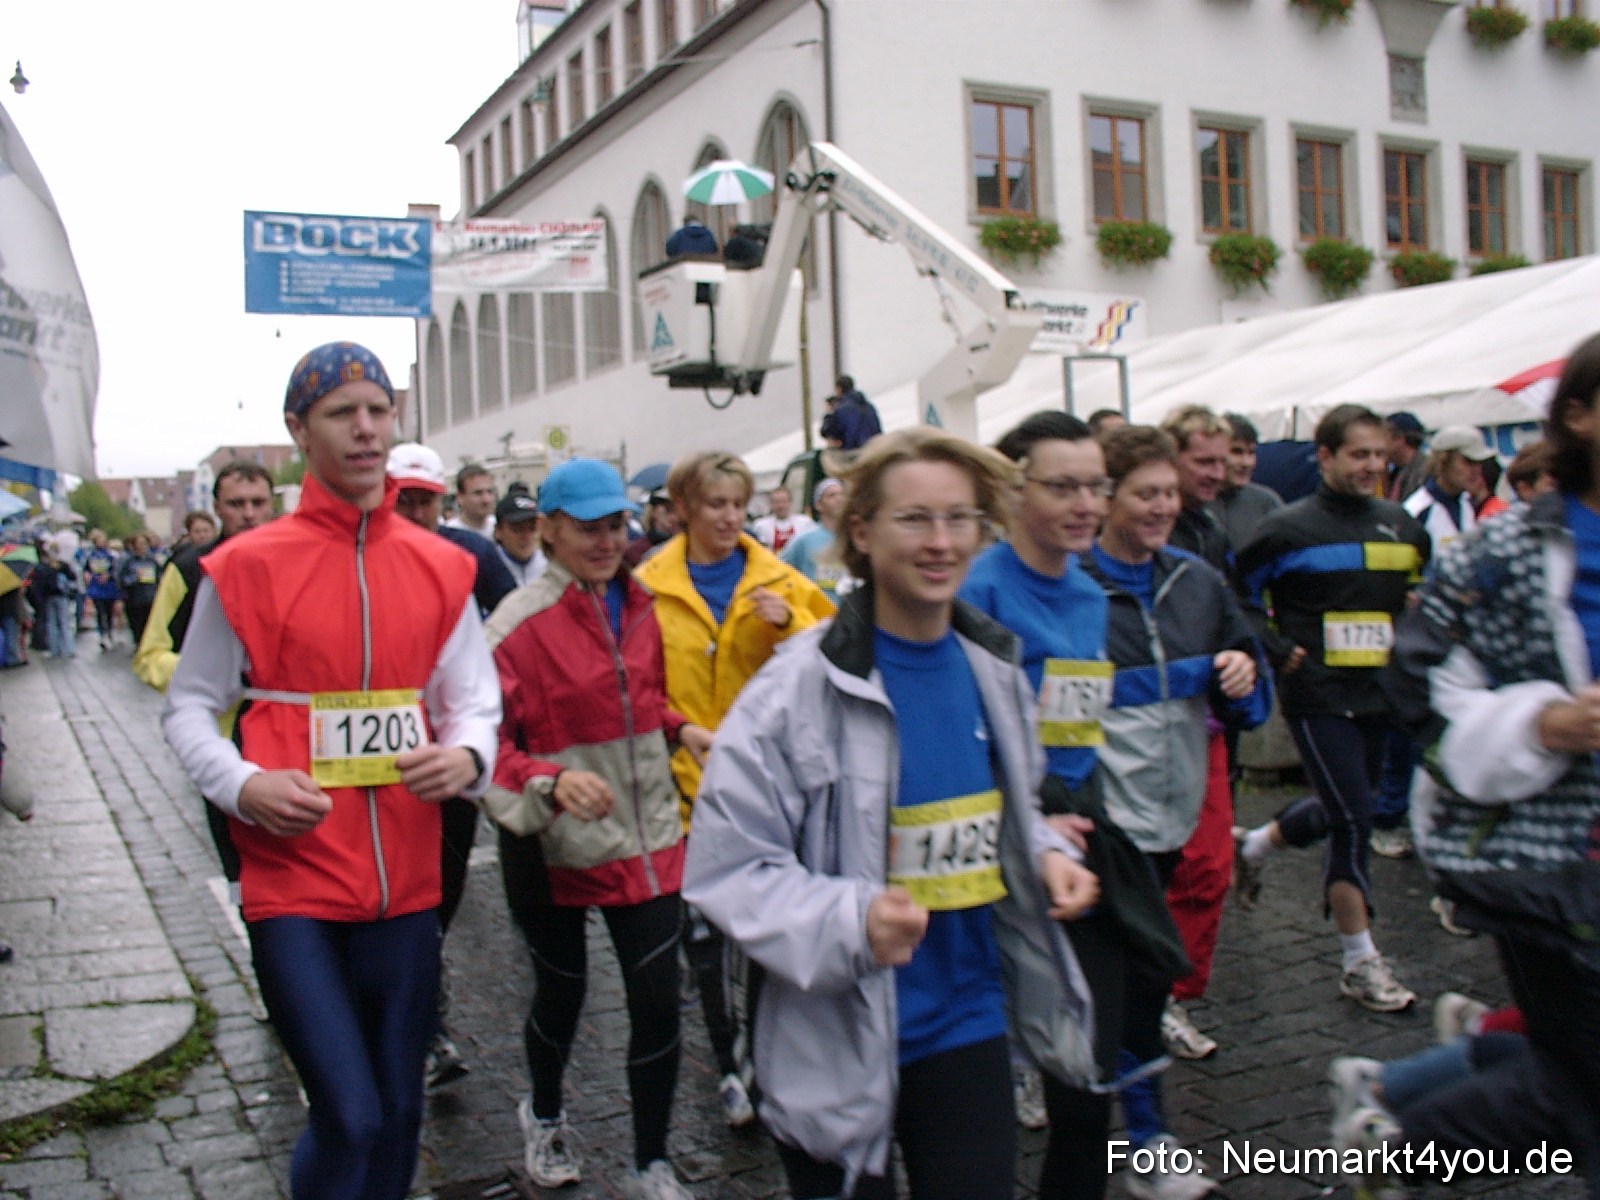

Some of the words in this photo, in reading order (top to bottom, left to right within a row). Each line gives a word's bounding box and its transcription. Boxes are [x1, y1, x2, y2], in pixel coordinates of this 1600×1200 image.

[254, 216, 420, 258] BOCK
[1343, 624, 1387, 646] 1775
[337, 711, 419, 755] 1203
[916, 818, 999, 872] 1429
